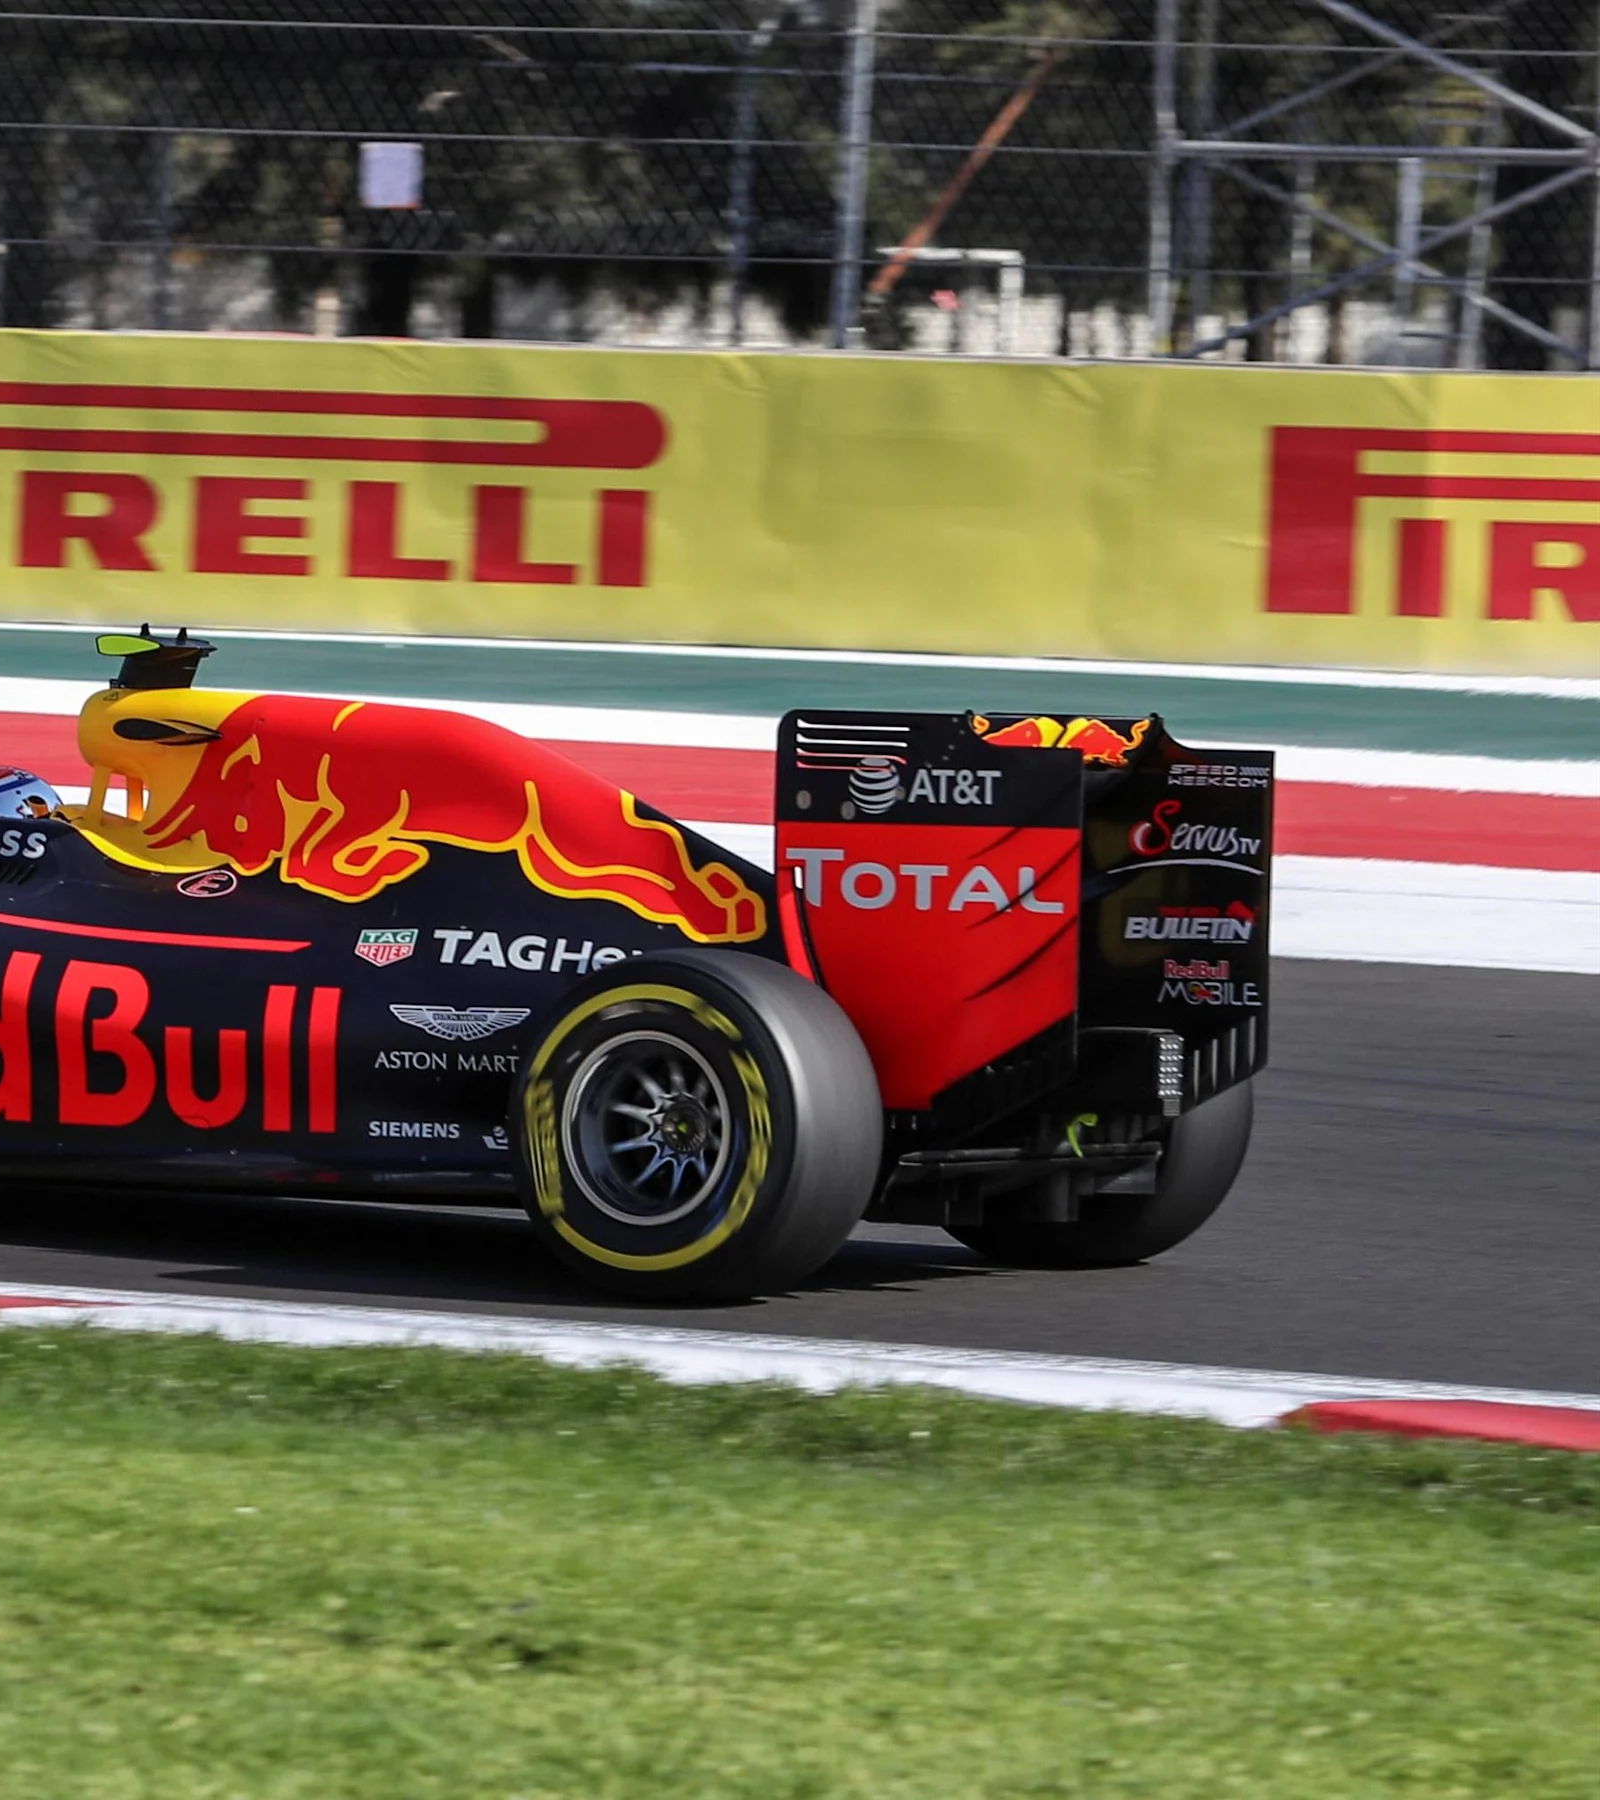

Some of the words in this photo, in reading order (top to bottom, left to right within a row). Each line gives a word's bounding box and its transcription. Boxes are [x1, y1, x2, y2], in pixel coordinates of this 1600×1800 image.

[1169, 763, 1237, 776] SPEED
[908, 768, 1002, 806] AT&T
[785, 847, 1065, 914] TOTAL
[366, 931, 413, 943] TAG
[357, 944, 411, 963] HEUER
[1156, 980, 1263, 1006] MOBILE
[374, 1050, 448, 1071] ASTON
[457, 1053, 520, 1074] MART
[368, 1120, 461, 1139] SIEMENS
